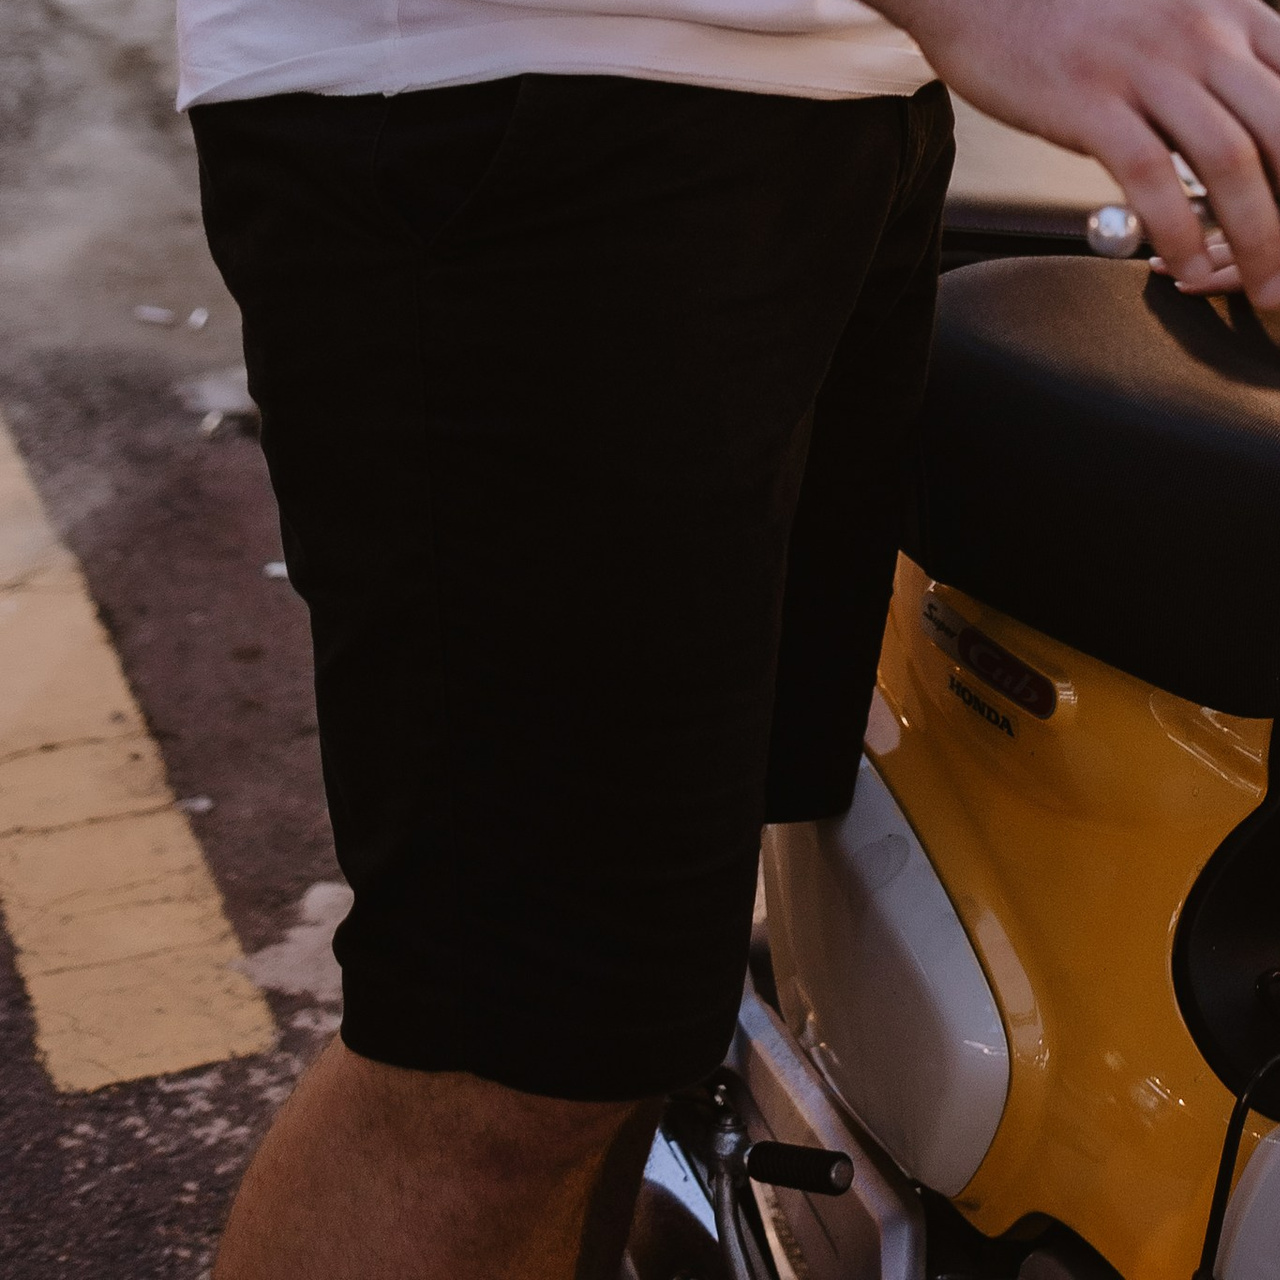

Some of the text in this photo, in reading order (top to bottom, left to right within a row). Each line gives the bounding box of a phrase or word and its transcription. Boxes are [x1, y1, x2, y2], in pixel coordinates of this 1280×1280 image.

[923, 602, 1039, 703] Super Cub
[948, 673, 1015, 738] HONDA
